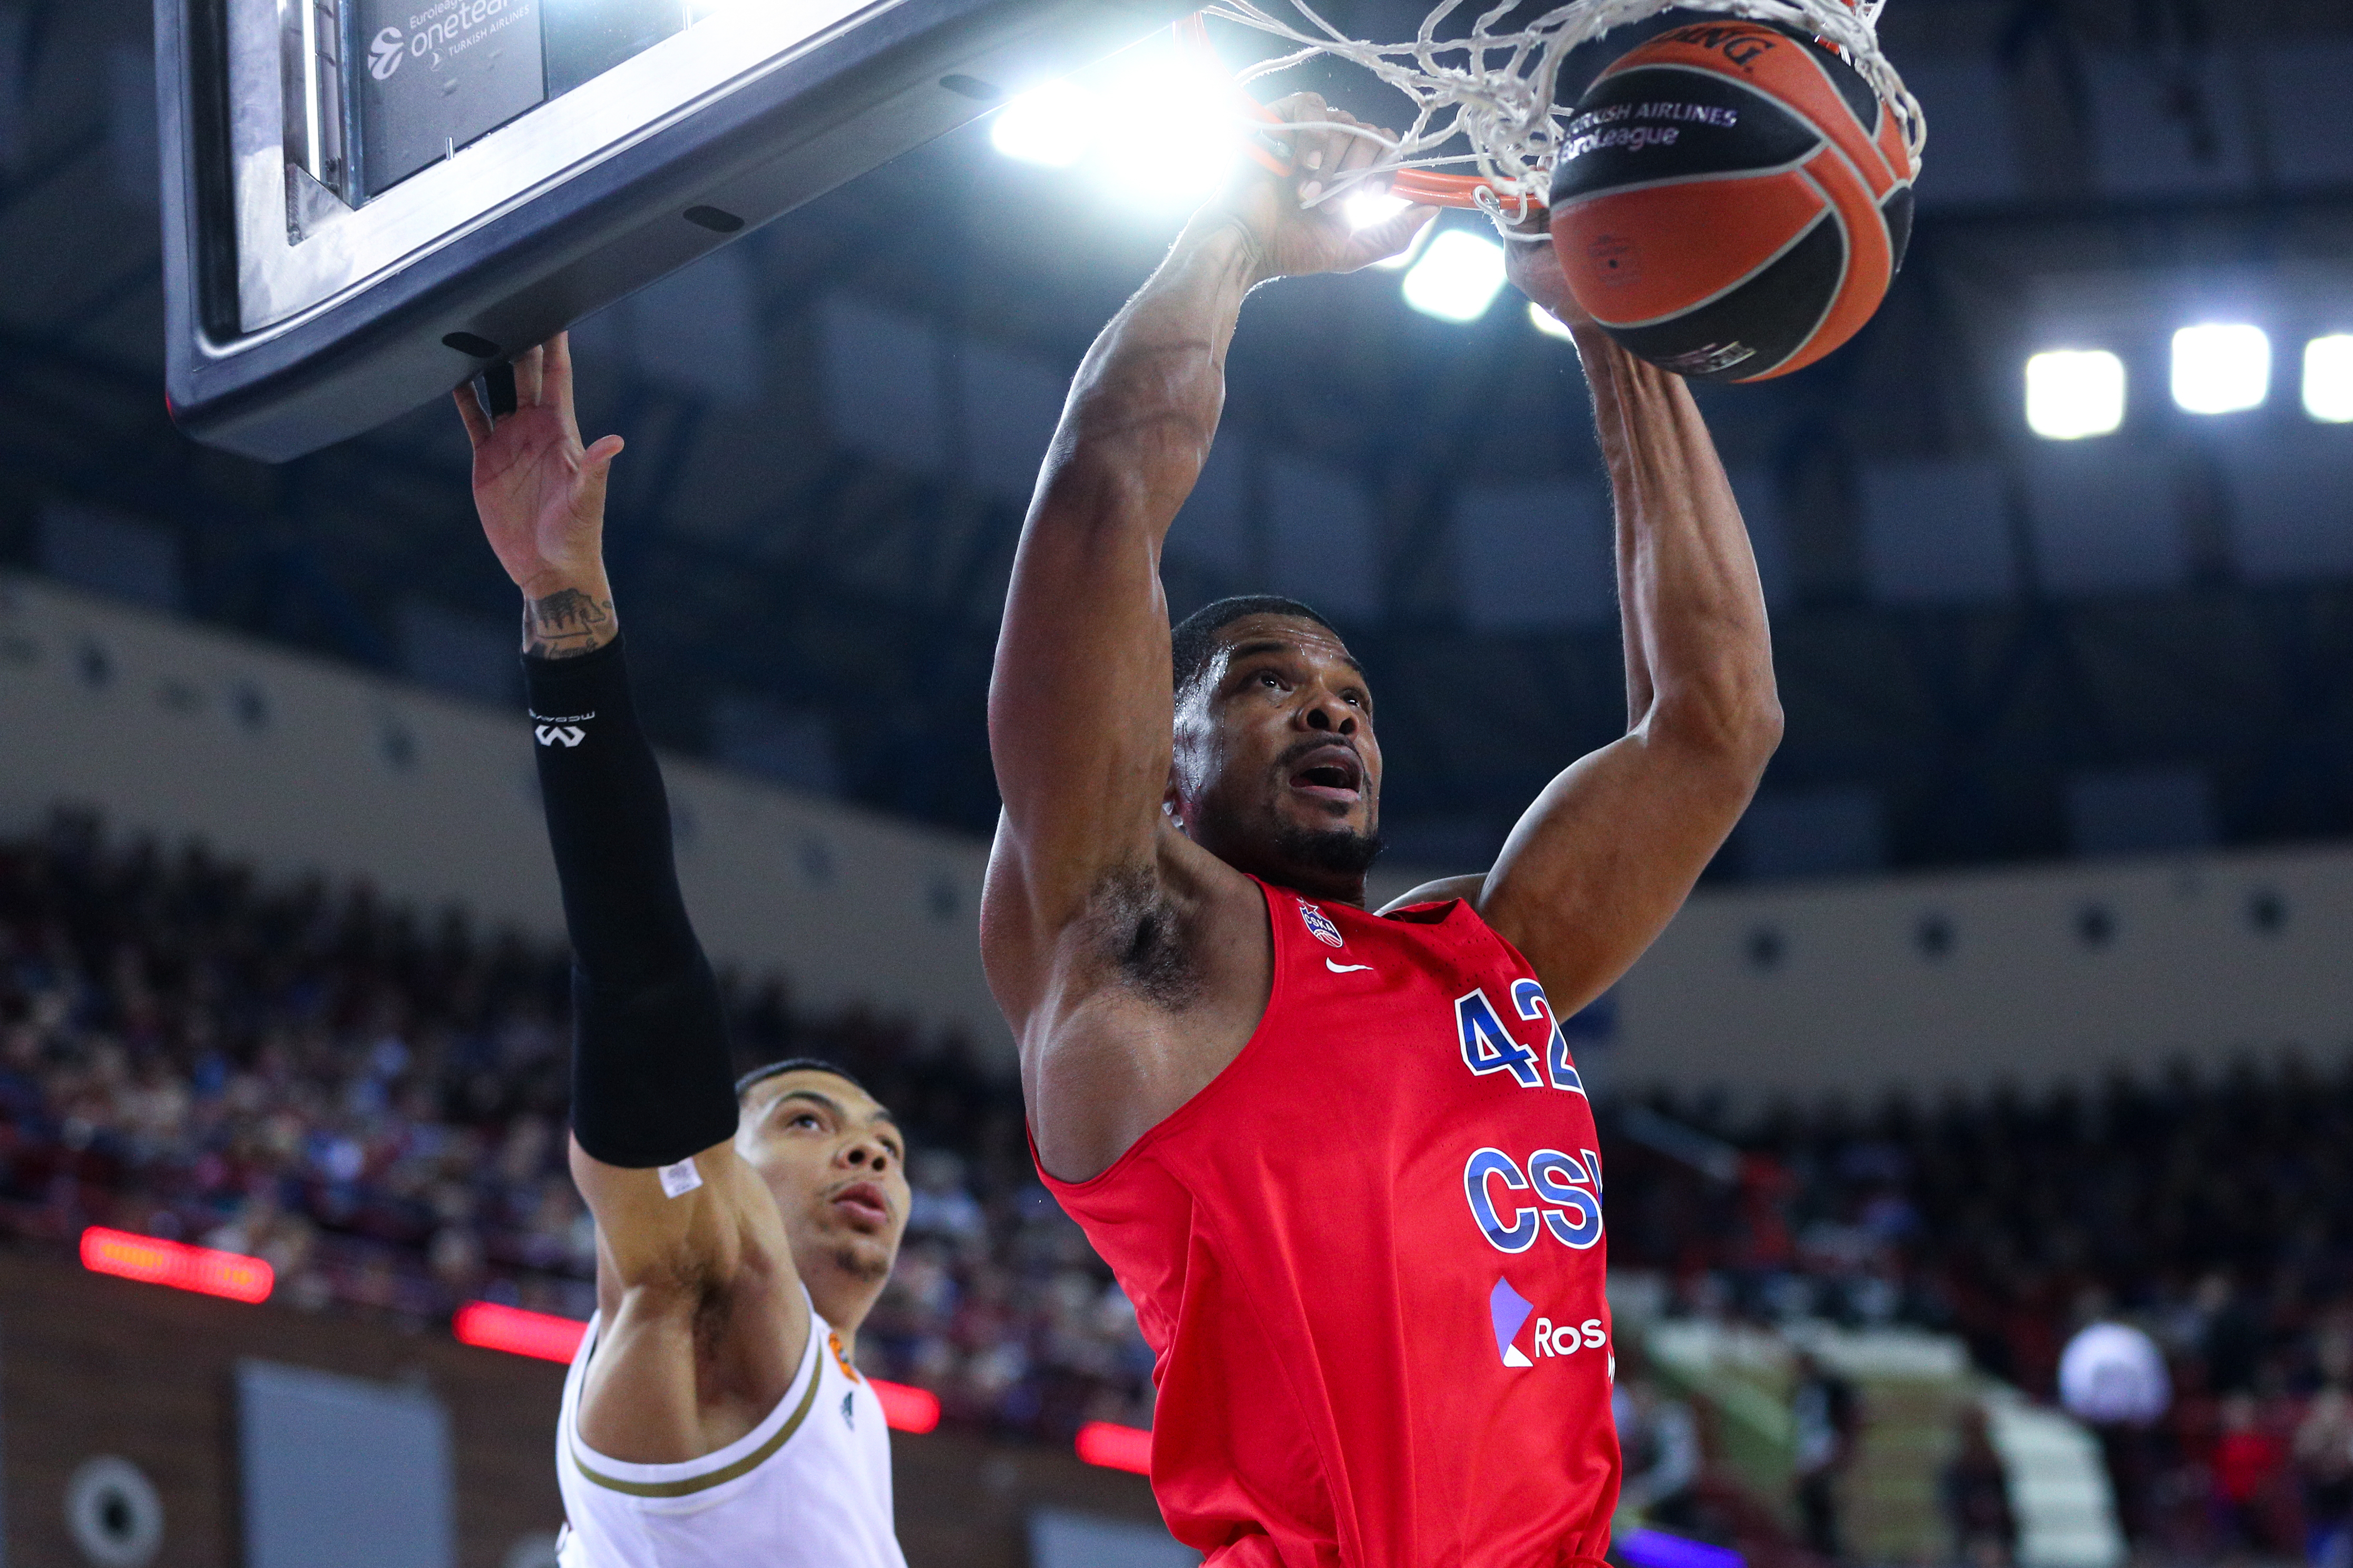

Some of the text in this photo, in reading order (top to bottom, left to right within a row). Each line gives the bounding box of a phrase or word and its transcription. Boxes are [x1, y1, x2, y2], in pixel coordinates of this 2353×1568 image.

[409, 0, 463, 28] Euroleag
[412, 0, 507, 56] onetea
[448, 5, 530, 56] TURKISH AIRLINES
[1635, 102, 1736, 128] AIRLINES
[1304, 914, 1335, 933] CSKA
[1454, 978, 1588, 1102] 42
[1535, 1317, 1606, 1358] Ros
